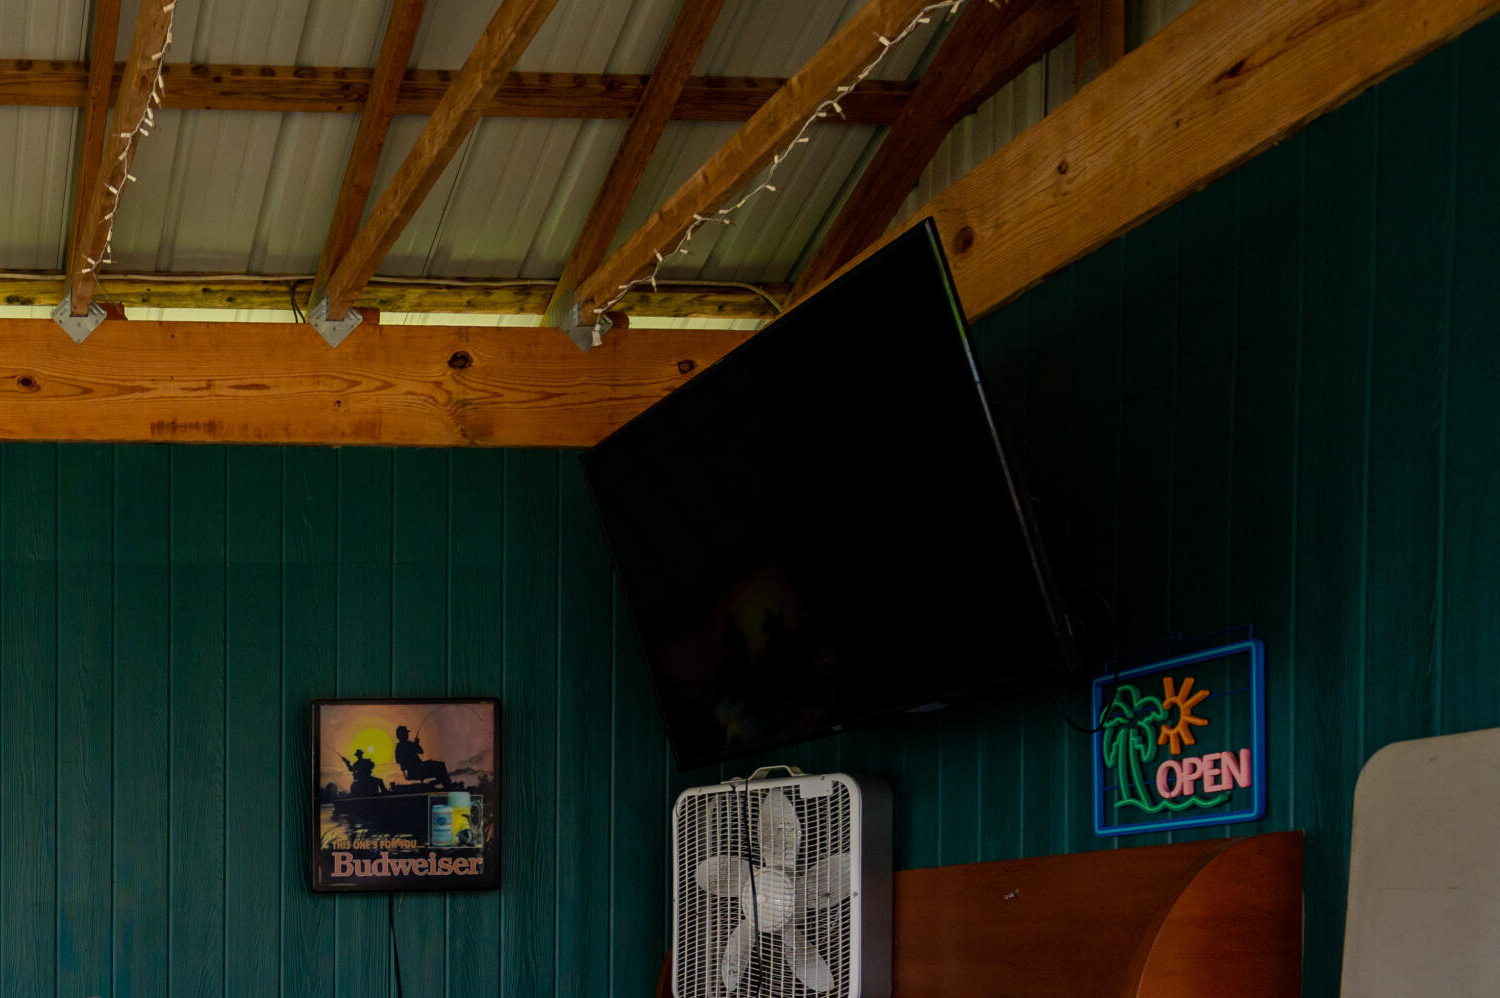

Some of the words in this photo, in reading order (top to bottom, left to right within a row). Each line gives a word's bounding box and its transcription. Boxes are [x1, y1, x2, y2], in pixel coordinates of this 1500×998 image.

[1156, 748, 1251, 799] OPEN
[331, 839, 351, 849] THIS
[379, 839, 397, 849] FOR
[331, 851, 483, 877] Budweiser
